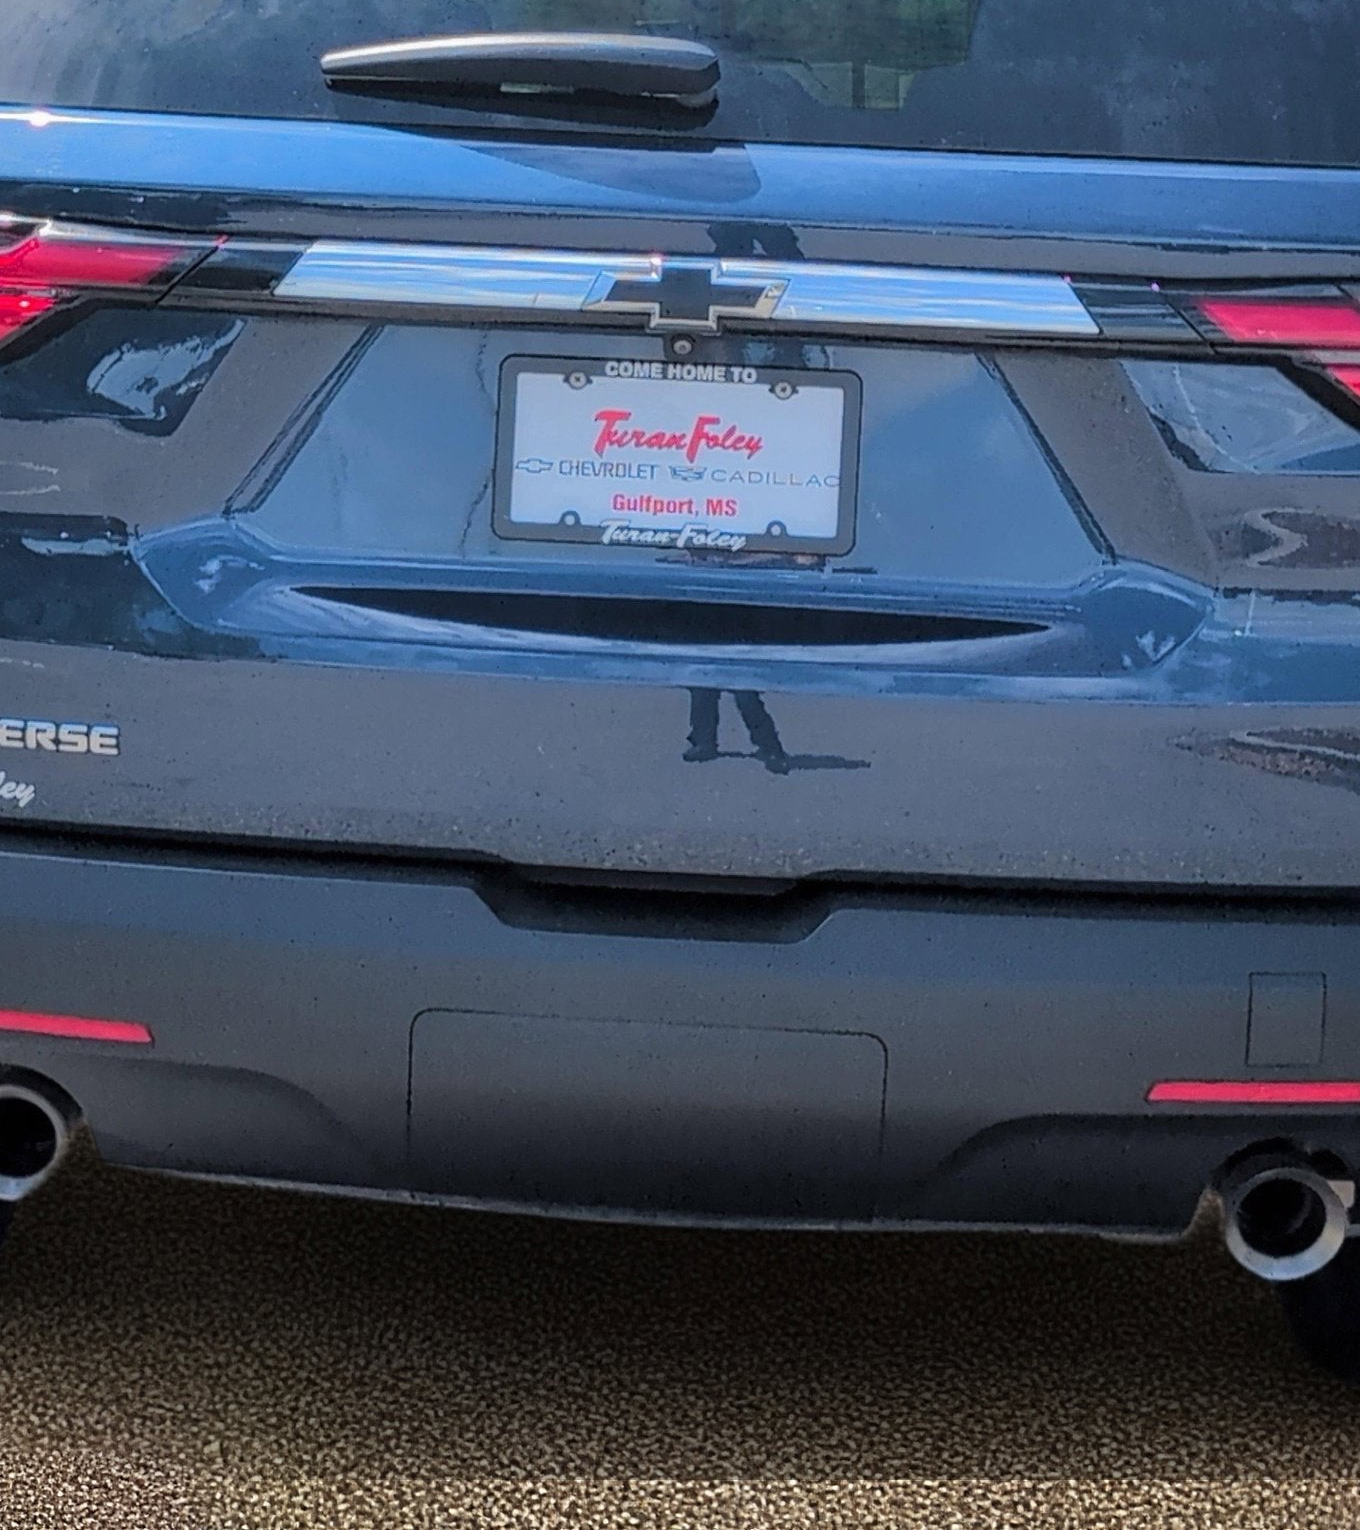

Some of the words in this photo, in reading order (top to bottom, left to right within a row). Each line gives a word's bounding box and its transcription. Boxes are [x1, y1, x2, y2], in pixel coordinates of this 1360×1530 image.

[604, 360, 663, 378] COME
[667, 363, 726, 382] HOME
[730, 367, 758, 384] TO
[594, 410, 688, 458] Turan
[686, 416, 764, 464] Foley
[558, 459, 658, 480] CHEVROLET
[710, 469, 841, 488] CADILLAC
[612, 494, 699, 517] Gulfport,
[705, 498, 738, 518] MS
